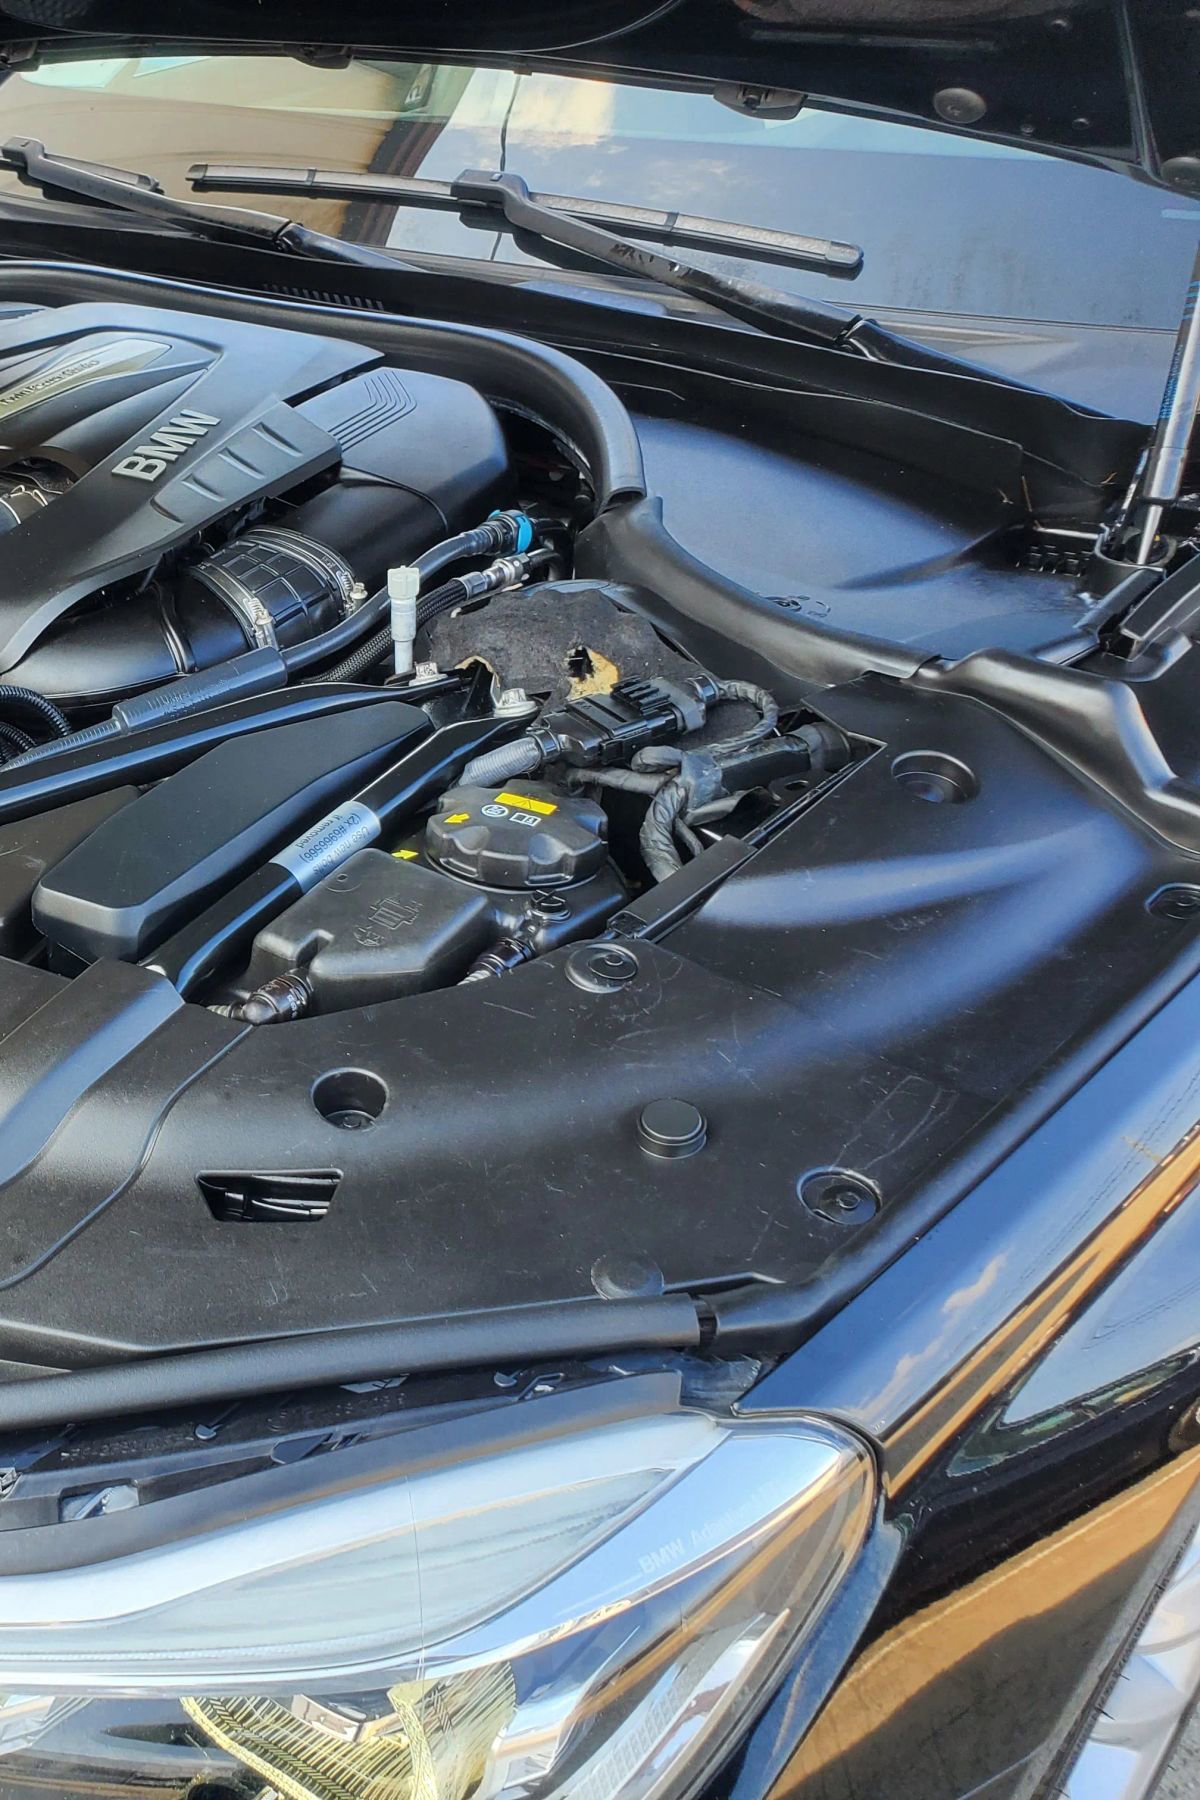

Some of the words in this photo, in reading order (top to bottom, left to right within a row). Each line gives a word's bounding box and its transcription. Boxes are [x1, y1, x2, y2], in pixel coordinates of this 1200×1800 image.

[111, 408, 221, 481] BMW
[296, 819, 334, 849] removed
[343, 812, 361, 827] (2x
[638, 1537, 685, 1574] BMW
